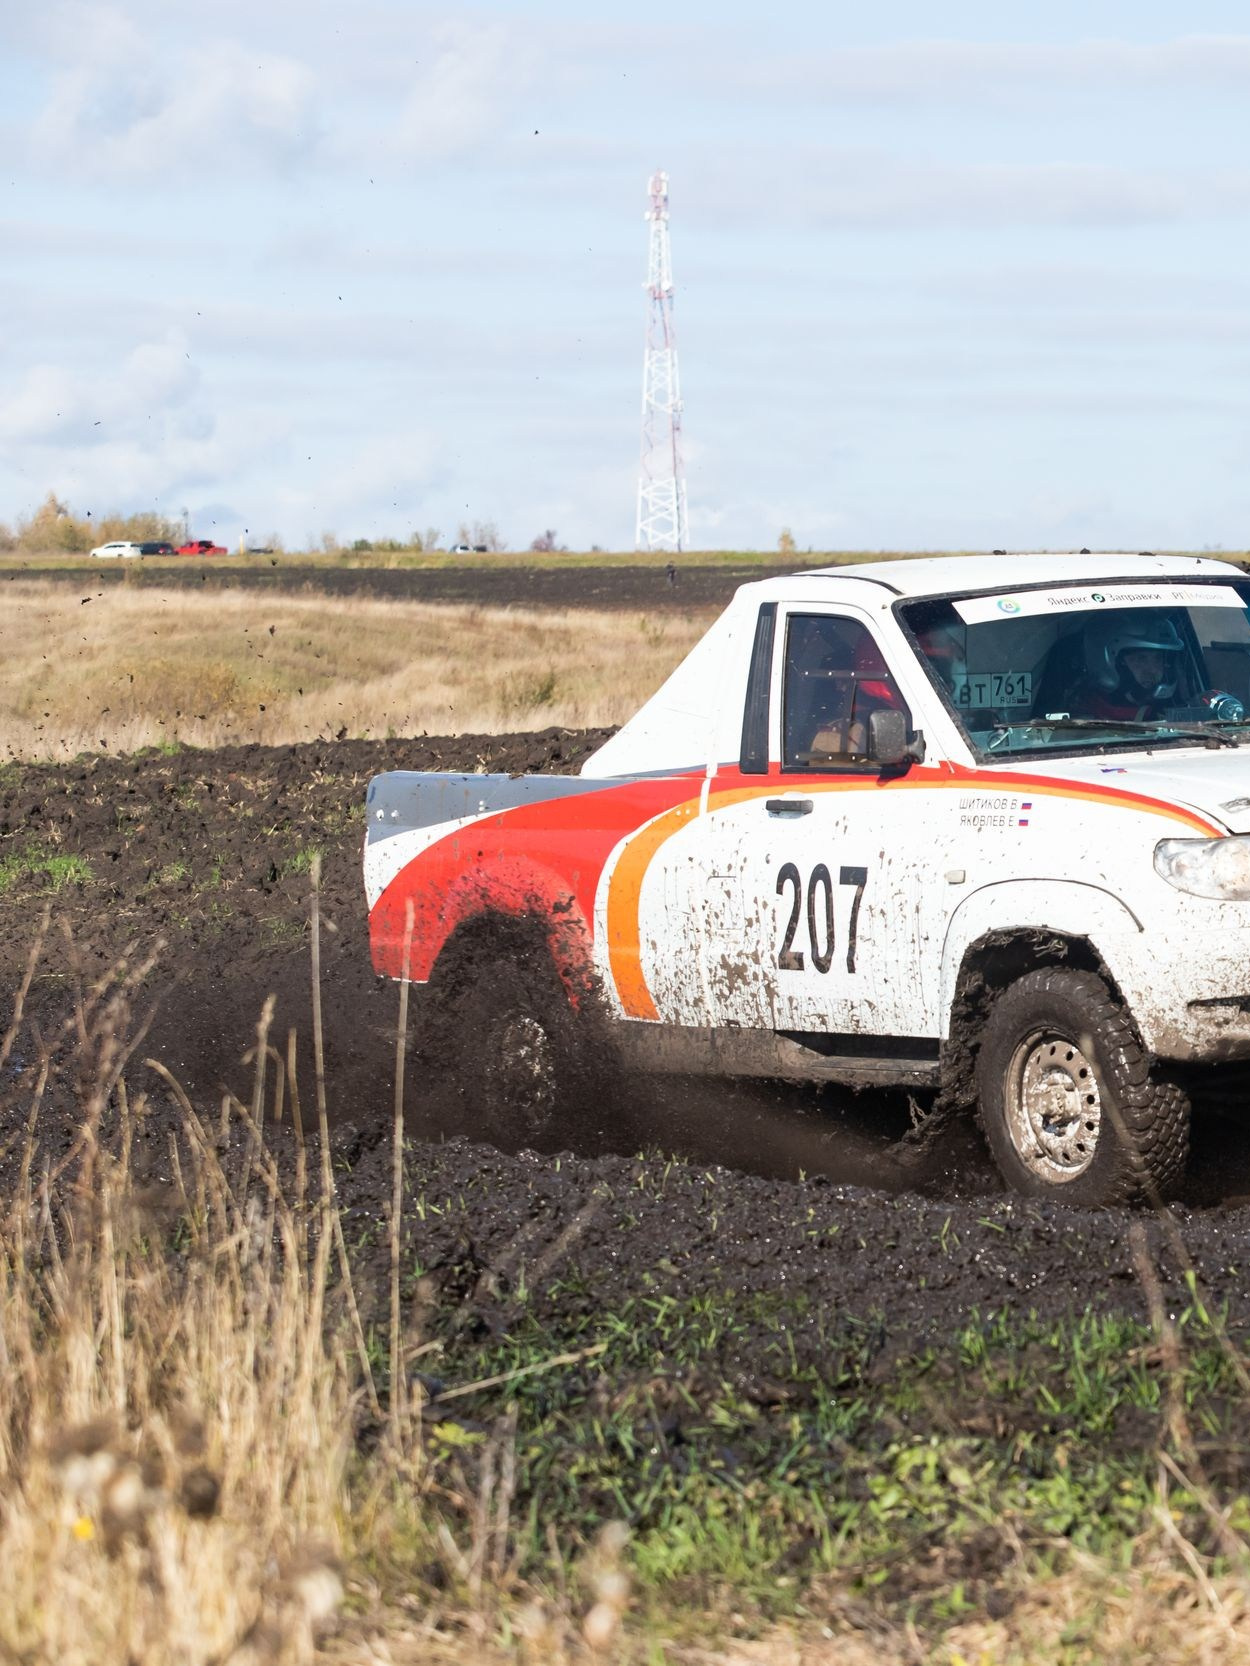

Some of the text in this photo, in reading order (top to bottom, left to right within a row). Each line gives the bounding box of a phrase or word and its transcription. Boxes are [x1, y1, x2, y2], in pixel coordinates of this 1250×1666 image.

[1047, 593, 1161, 606] Яндекс Заправки
[993, 675, 1025, 696] 761
[960, 798, 1008, 810] ШИТИКОВ
[960, 815, 1015, 827] ЯКОВЛЕВ Е
[776, 862, 868, 974] 207
